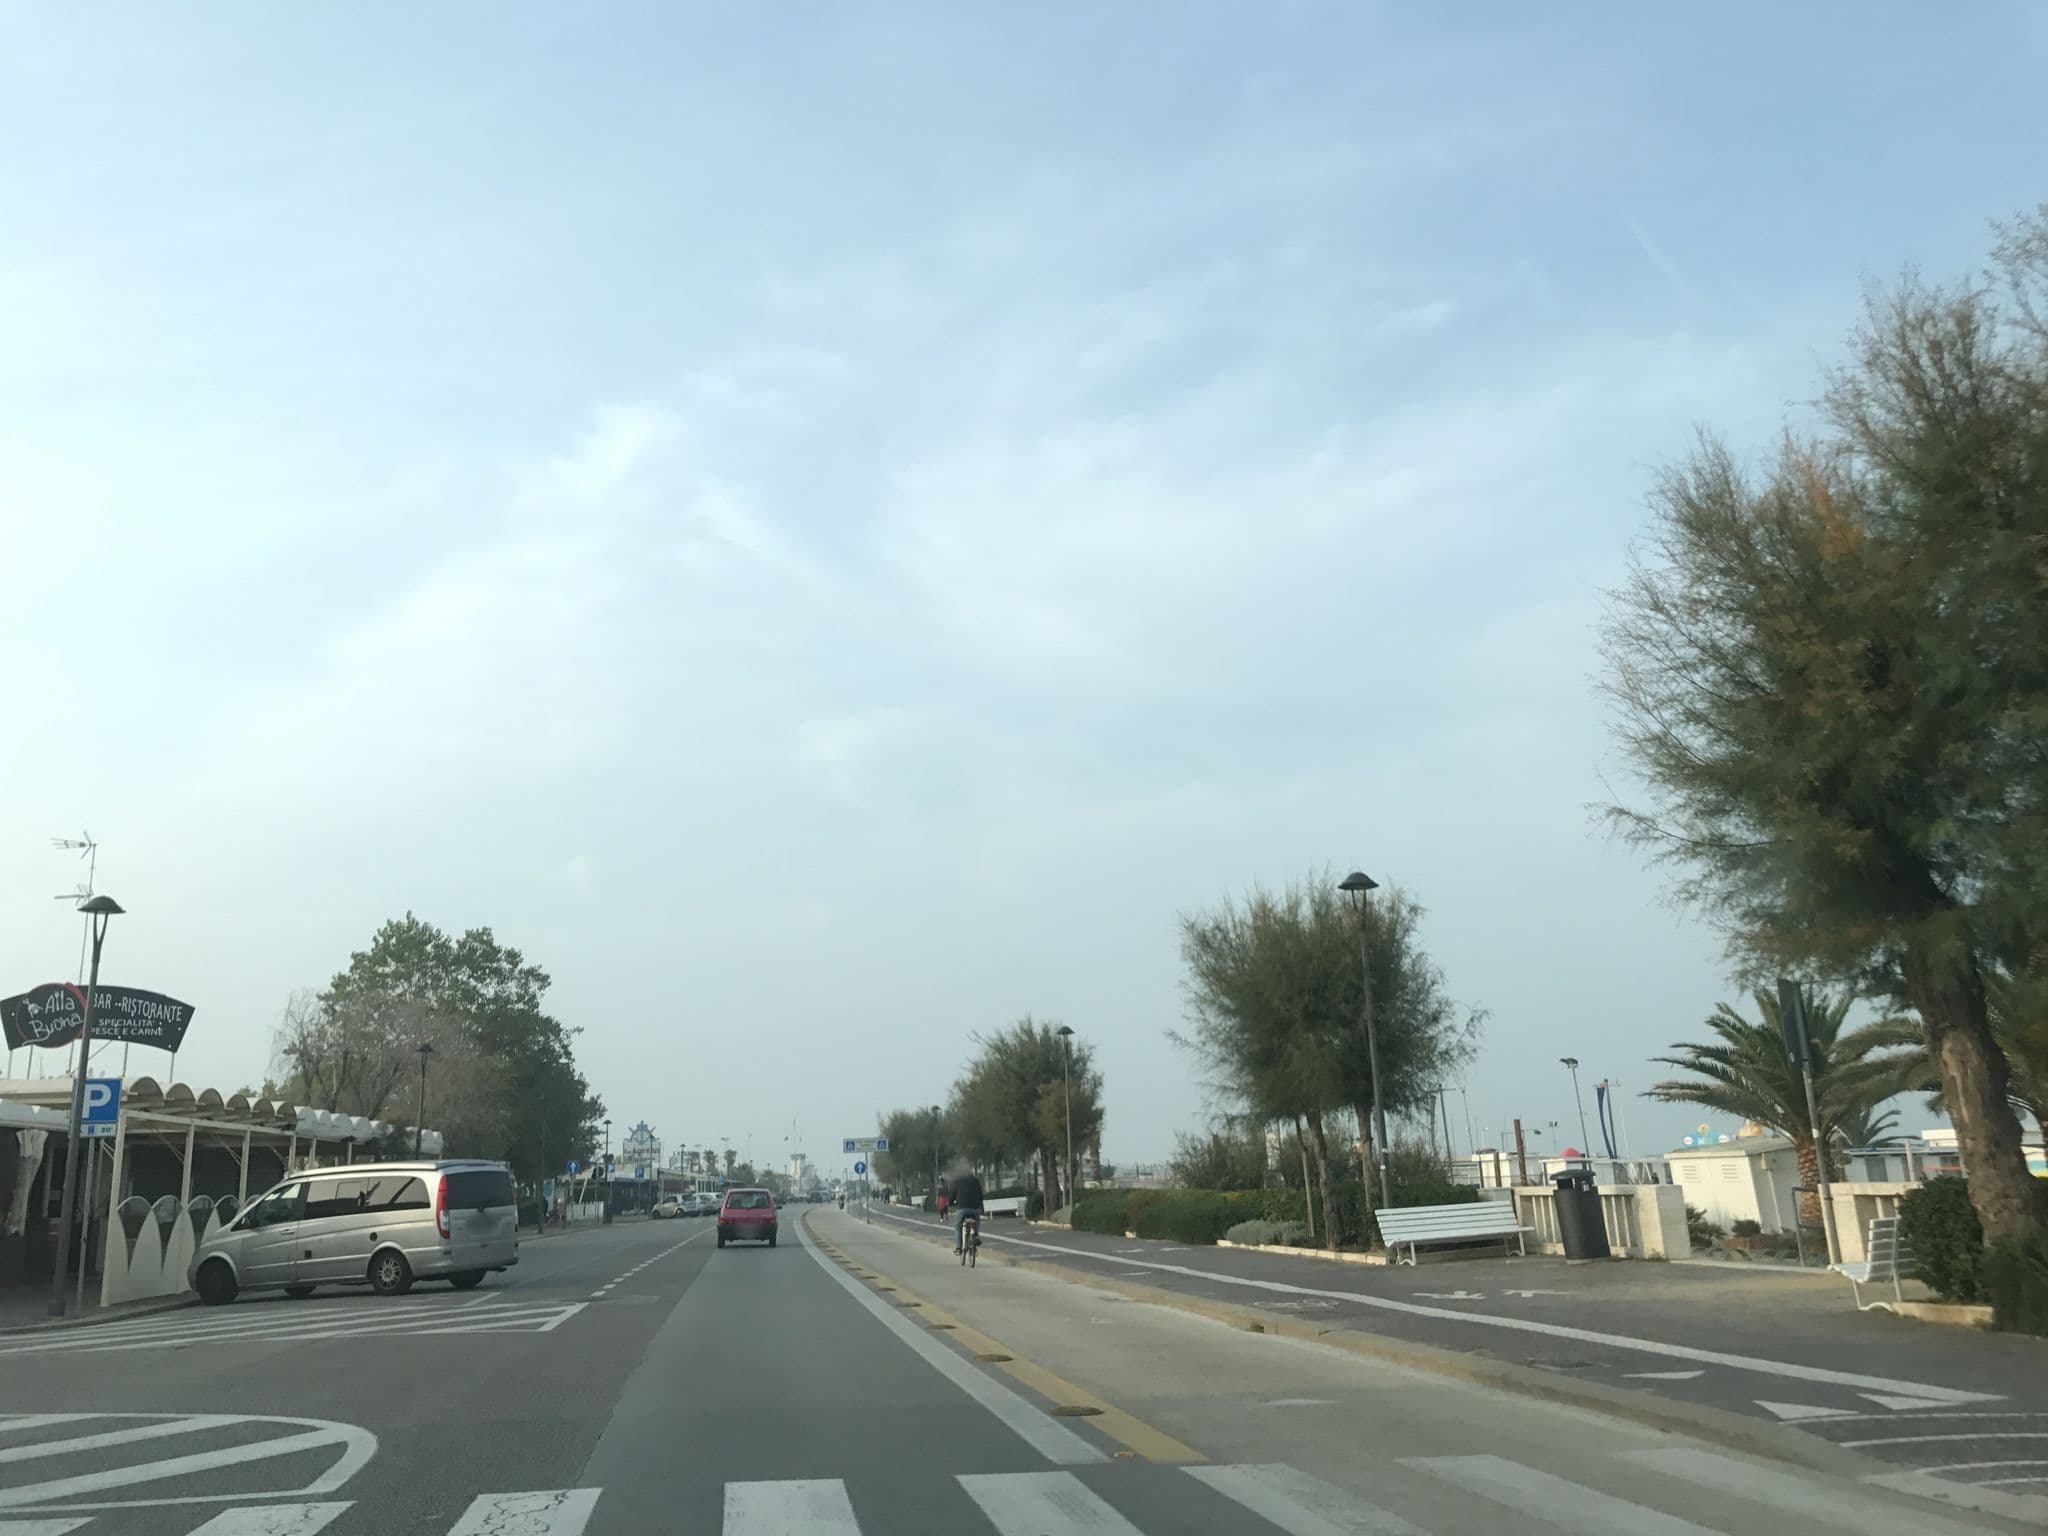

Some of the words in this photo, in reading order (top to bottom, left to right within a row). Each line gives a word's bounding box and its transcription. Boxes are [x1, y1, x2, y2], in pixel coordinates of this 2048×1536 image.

[44, 989, 75, 1014] Alla
[93, 992, 112, 1010] BAR
[121, 996, 183, 1022] RISTORANTE
[26, 1013, 84, 1042] Buona
[122, 1028, 128, 1036] E
[130, 1028, 164, 1037] CARNE
[82, 1083, 112, 1119] P
